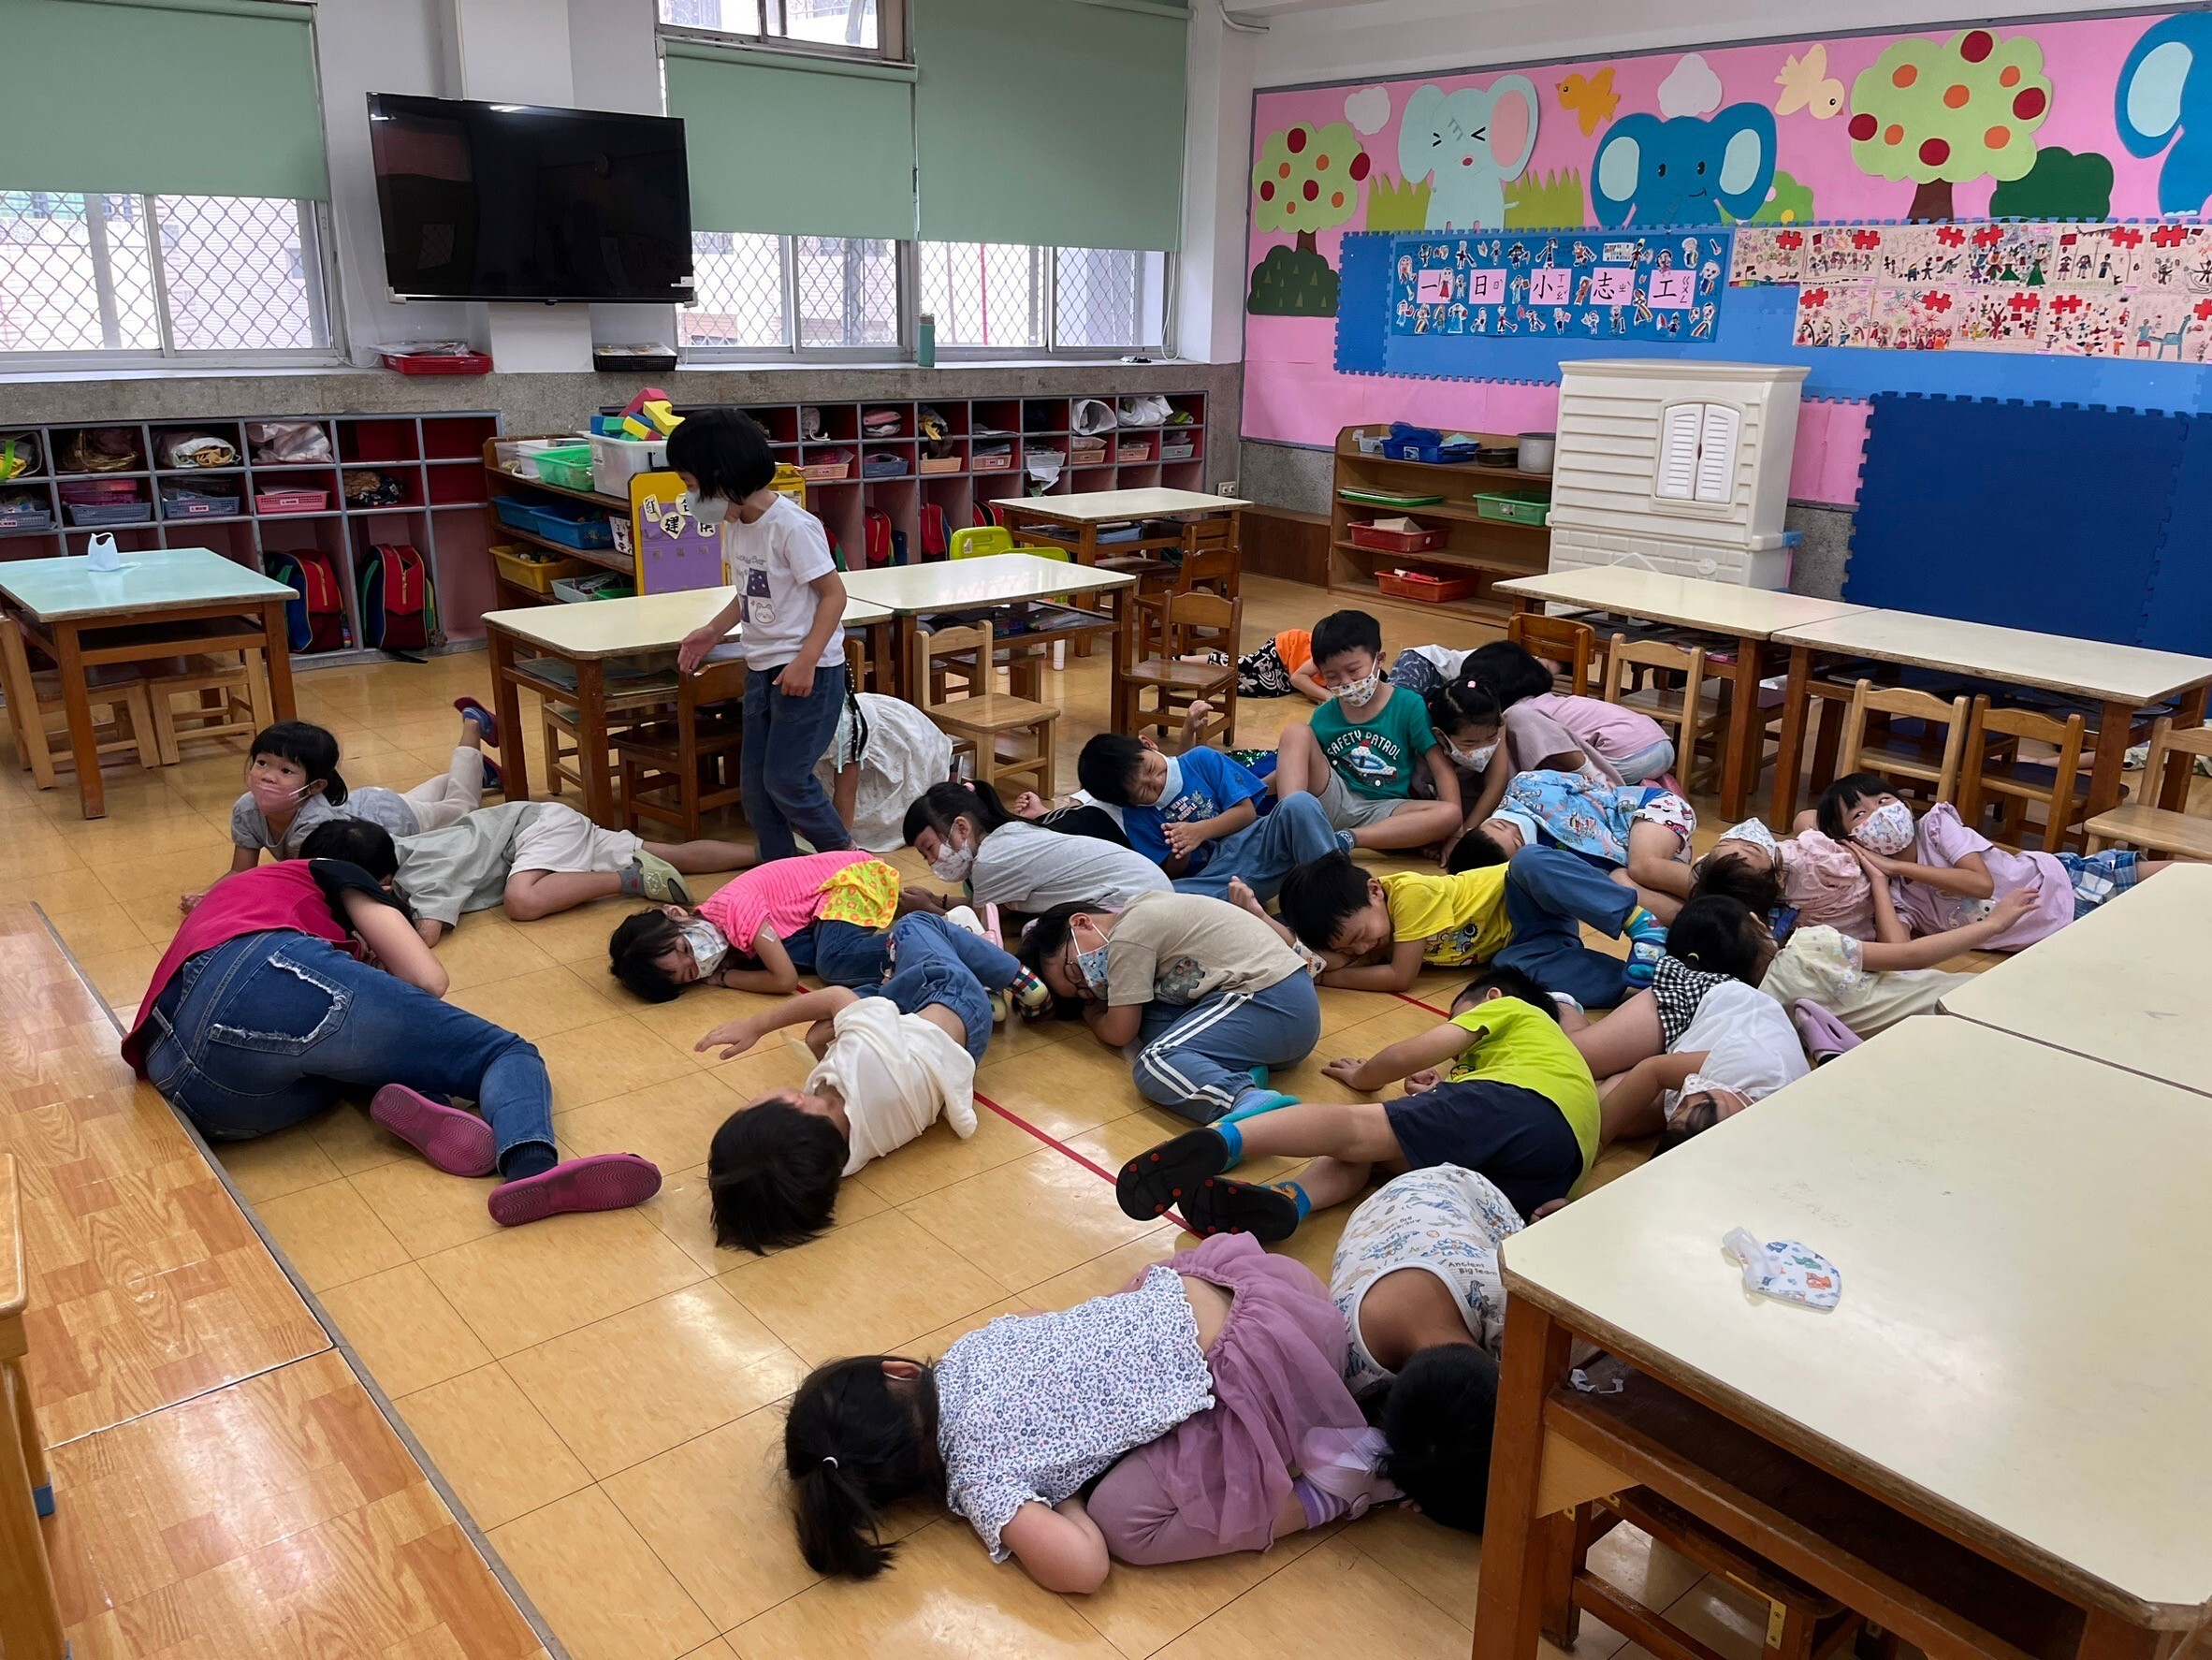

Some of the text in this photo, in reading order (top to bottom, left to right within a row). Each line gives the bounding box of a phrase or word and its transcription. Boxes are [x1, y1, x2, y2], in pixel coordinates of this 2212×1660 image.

[1474, 274, 1488, 296] 日
[1532, 274, 1553, 299] 小
[1593, 271, 1615, 299] 志
[1652, 279, 1678, 299] 工
[1327, 729, 1401, 761] SAFETY PATROL
